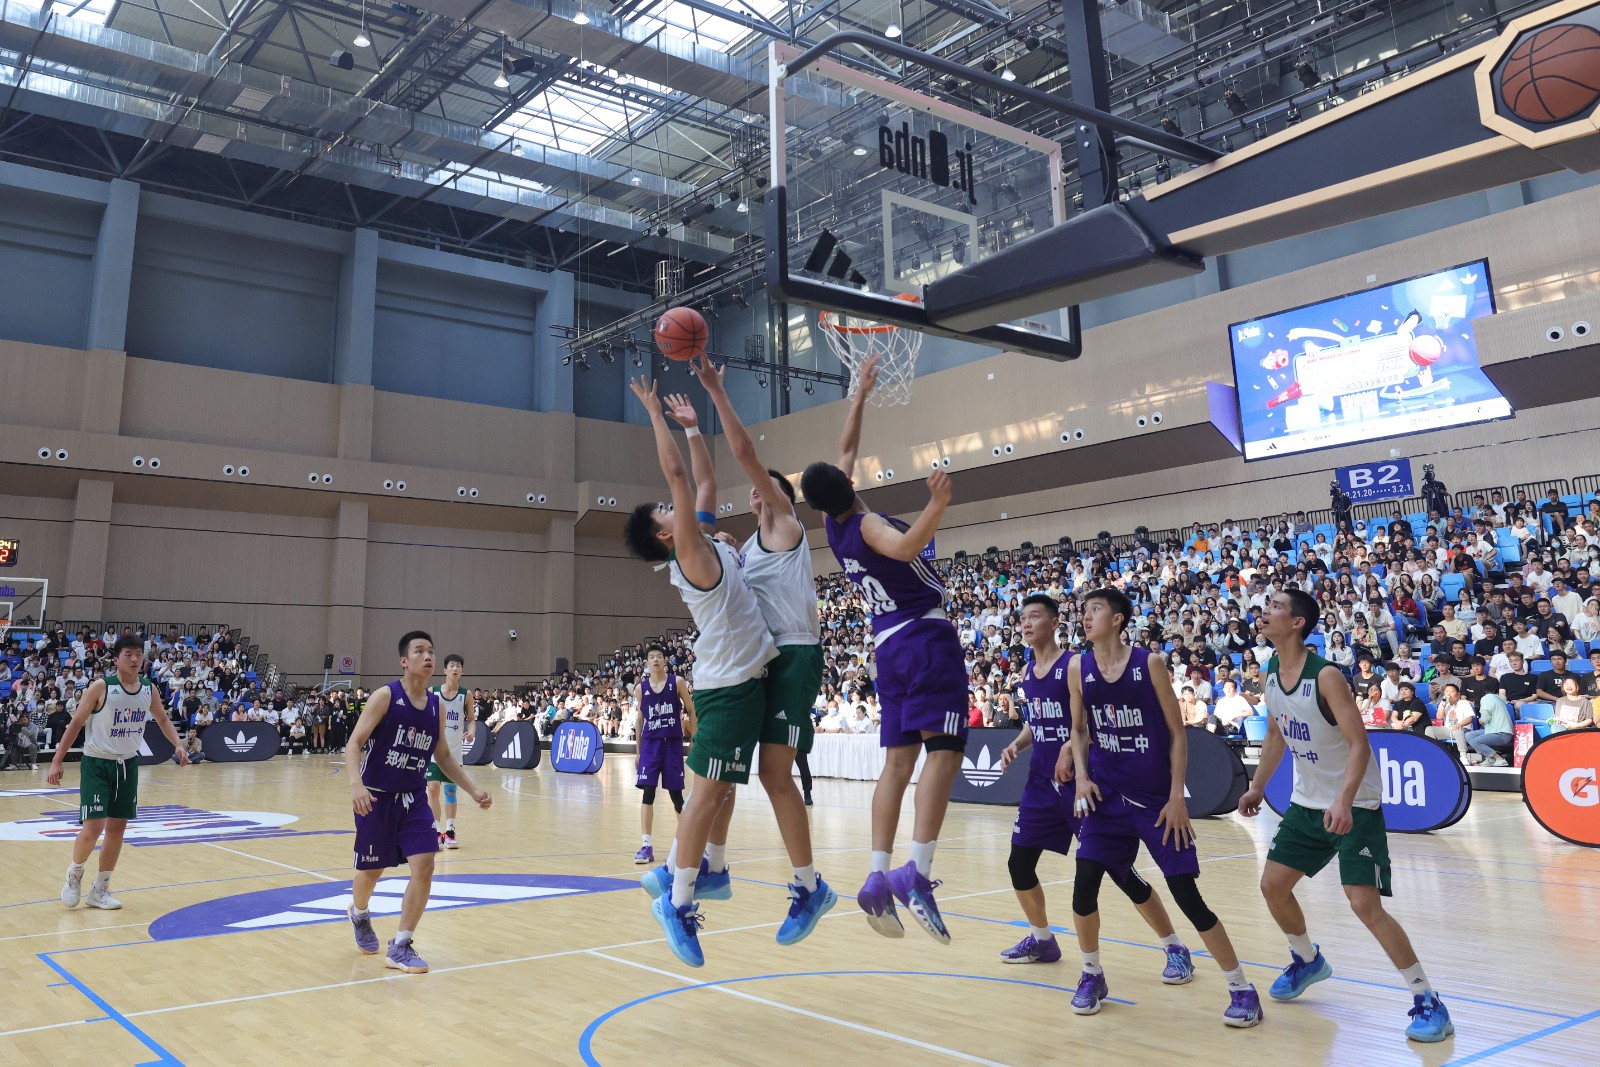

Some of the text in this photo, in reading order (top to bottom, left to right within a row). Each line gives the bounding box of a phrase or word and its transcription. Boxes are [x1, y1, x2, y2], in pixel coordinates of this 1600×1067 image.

[1348, 464, 1401, 489] B2
[1132, 666, 1142, 682] 15
[1302, 683, 1312, 697] 10
[112, 708, 146, 726] jr. nba
[1041, 697, 1064, 719] nba
[1091, 704, 1144, 730] jr. nba
[109, 726, 143, 738] 郑州十一中
[392, 724, 433, 751] jr. nba
[1096, 731, 1149, 754] 郑州二中
[555, 728, 590, 764] jr. nba
[734, 747, 741, 761] 6
[384, 748, 426, 773] 郑州二中
[1558, 767, 1600, 807] G
